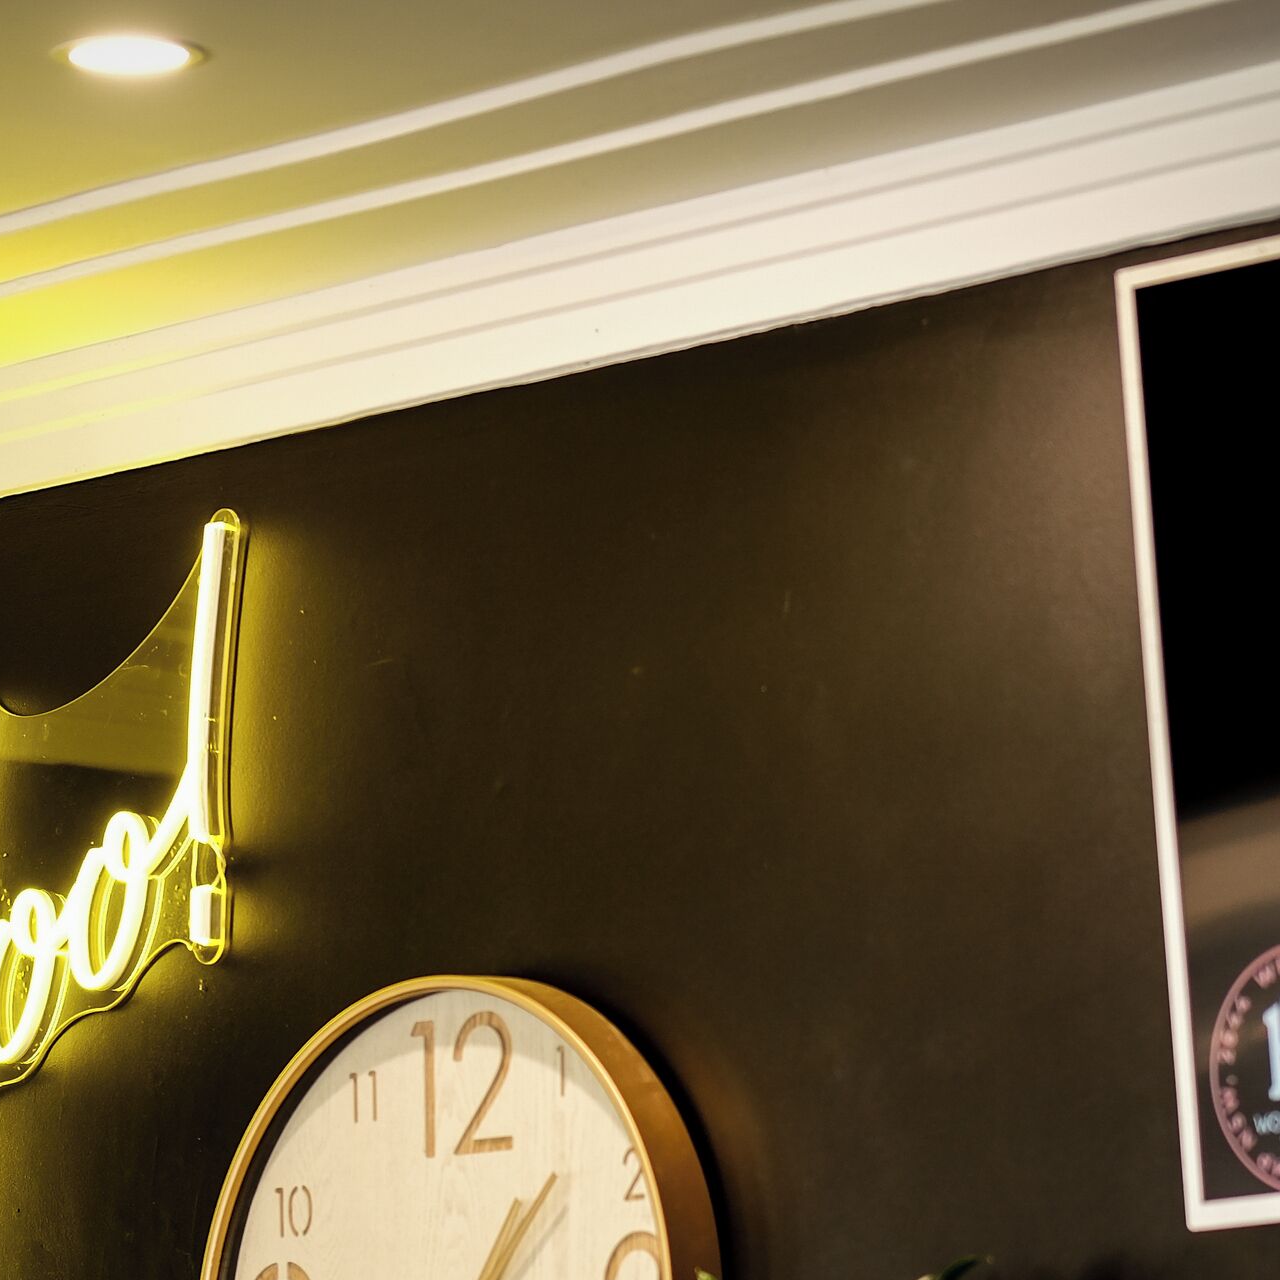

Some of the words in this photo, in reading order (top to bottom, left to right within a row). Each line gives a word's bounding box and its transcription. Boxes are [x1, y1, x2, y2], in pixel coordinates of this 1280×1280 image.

[348, 1070, 379, 1123] 11
[410, 1011, 514, 1159] 12
[556, 1045, 566, 1097] 1
[274, 1185, 313, 1239] 10
